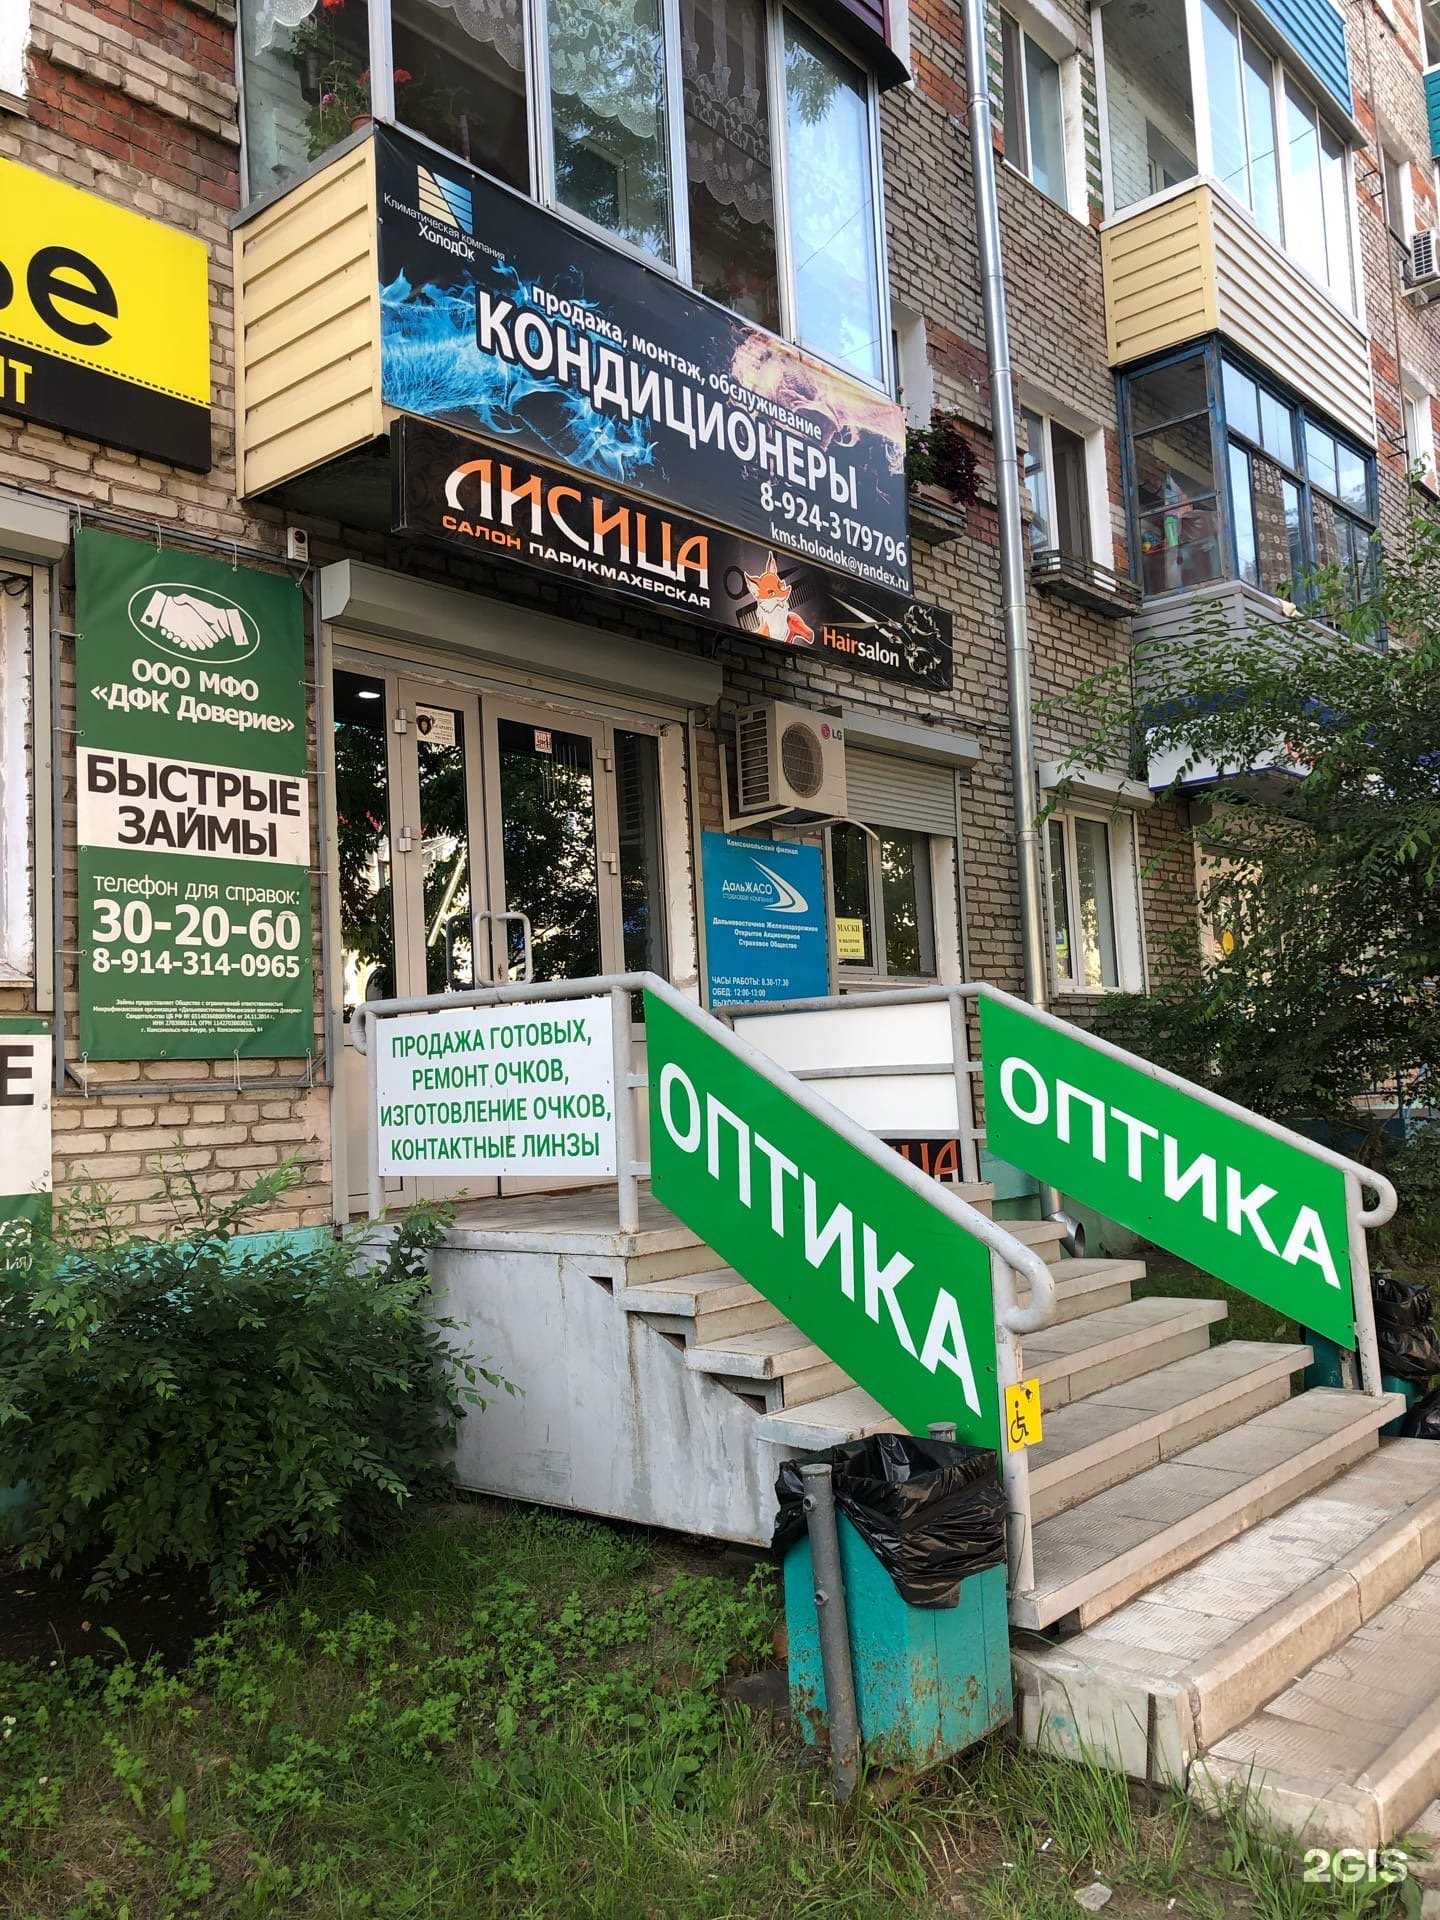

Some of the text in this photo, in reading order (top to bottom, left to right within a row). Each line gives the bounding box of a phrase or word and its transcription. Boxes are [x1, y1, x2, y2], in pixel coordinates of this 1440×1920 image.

[384, 192, 505, 262] Климатическая компания
[418, 223, 475, 262] ХолодОк
[0, 246, 118, 346] е
[532, 286, 822, 441] продажа, монтаж, обслуживание
[479, 290, 858, 509] КОНДИЦИОНЕРЫ
[444, 459, 709, 589] ЛИСИЦА
[760, 481, 908, 567] 8-924-3179796
[442, 515, 711, 609] САЛОН ПАРИКМАХЕРСКАЯ
[771, 521, 910, 591] kms.holodok@yandex.ru
[132, 658, 259, 701] ООО МФО
[91, 683, 295, 732] «ДФК Доверие»
[832, 730, 843, 740] LG
[87, 754, 301, 817] БЫСТРЫЕ
[118, 805, 277, 857] ЗАЙМЫ
[92, 875, 300, 906] телефон для справок:
[722, 879, 773, 895] ДальЖАСО
[92, 898, 301, 950] 30-20-60
[92, 948, 300, 978] 8-914-314-0965
[712, 976, 731, 985] ЧАСЫ
[392, 1019, 592, 1060] ПРОДАЖА ГОТОВЫХ,
[412, 1058, 569, 1091] РЕМОНТ ОЧКОВ,
[380, 1093, 611, 1127] ИЗГОТОВЛЕНИЕ ОЧКОВ,
[391, 1132, 600, 1161] КОНТАКТНЫЕ ЛИНЗЫ
[1000, 1056, 1341, 1290] ОПТИКА
[660, 1062, 982, 1418] ОПТИКА
